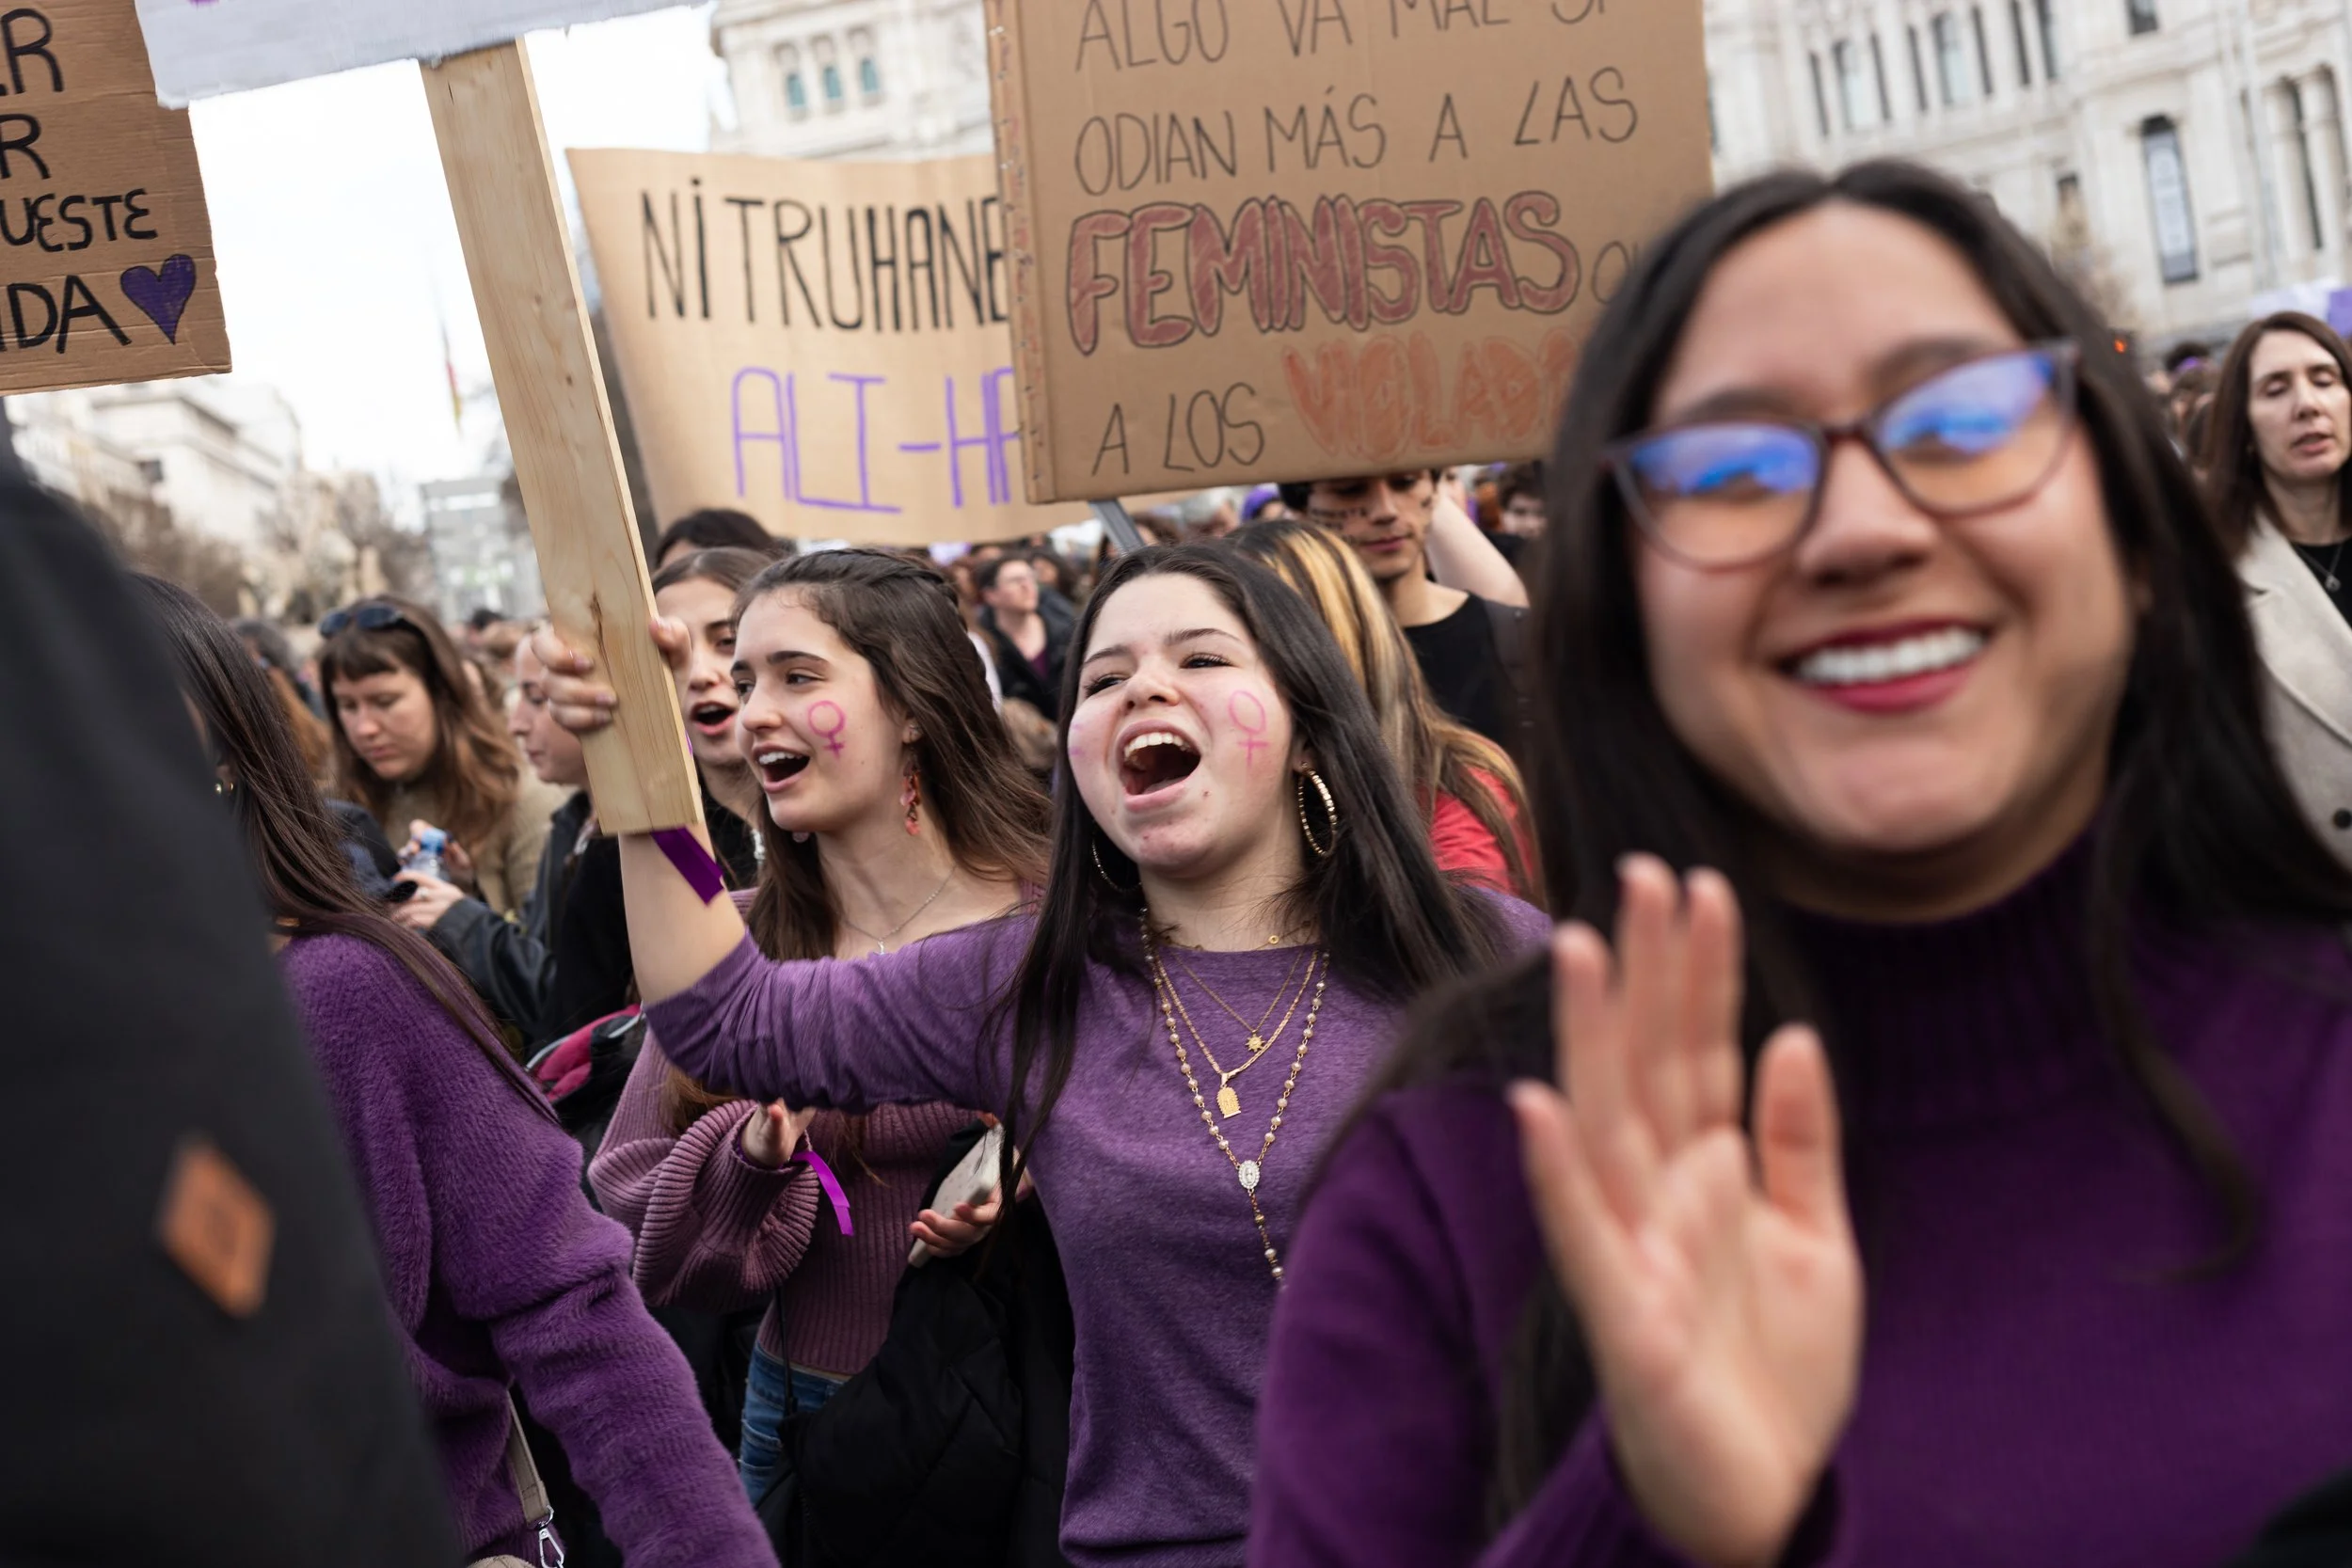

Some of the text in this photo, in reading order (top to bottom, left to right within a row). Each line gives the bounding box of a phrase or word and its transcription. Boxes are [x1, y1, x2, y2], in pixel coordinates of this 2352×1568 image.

[0, 8, 64, 95] R
[1074, 0, 1229, 72] ALGO
[1275, 0, 1354, 57] VA
[1074, 67, 1638, 196] ODIAN MÁS A LAS
[1067, 190, 1581, 356] FEMINISTAS
[1091, 403, 1129, 477] A
[1163, 382, 1265, 472] LOS
